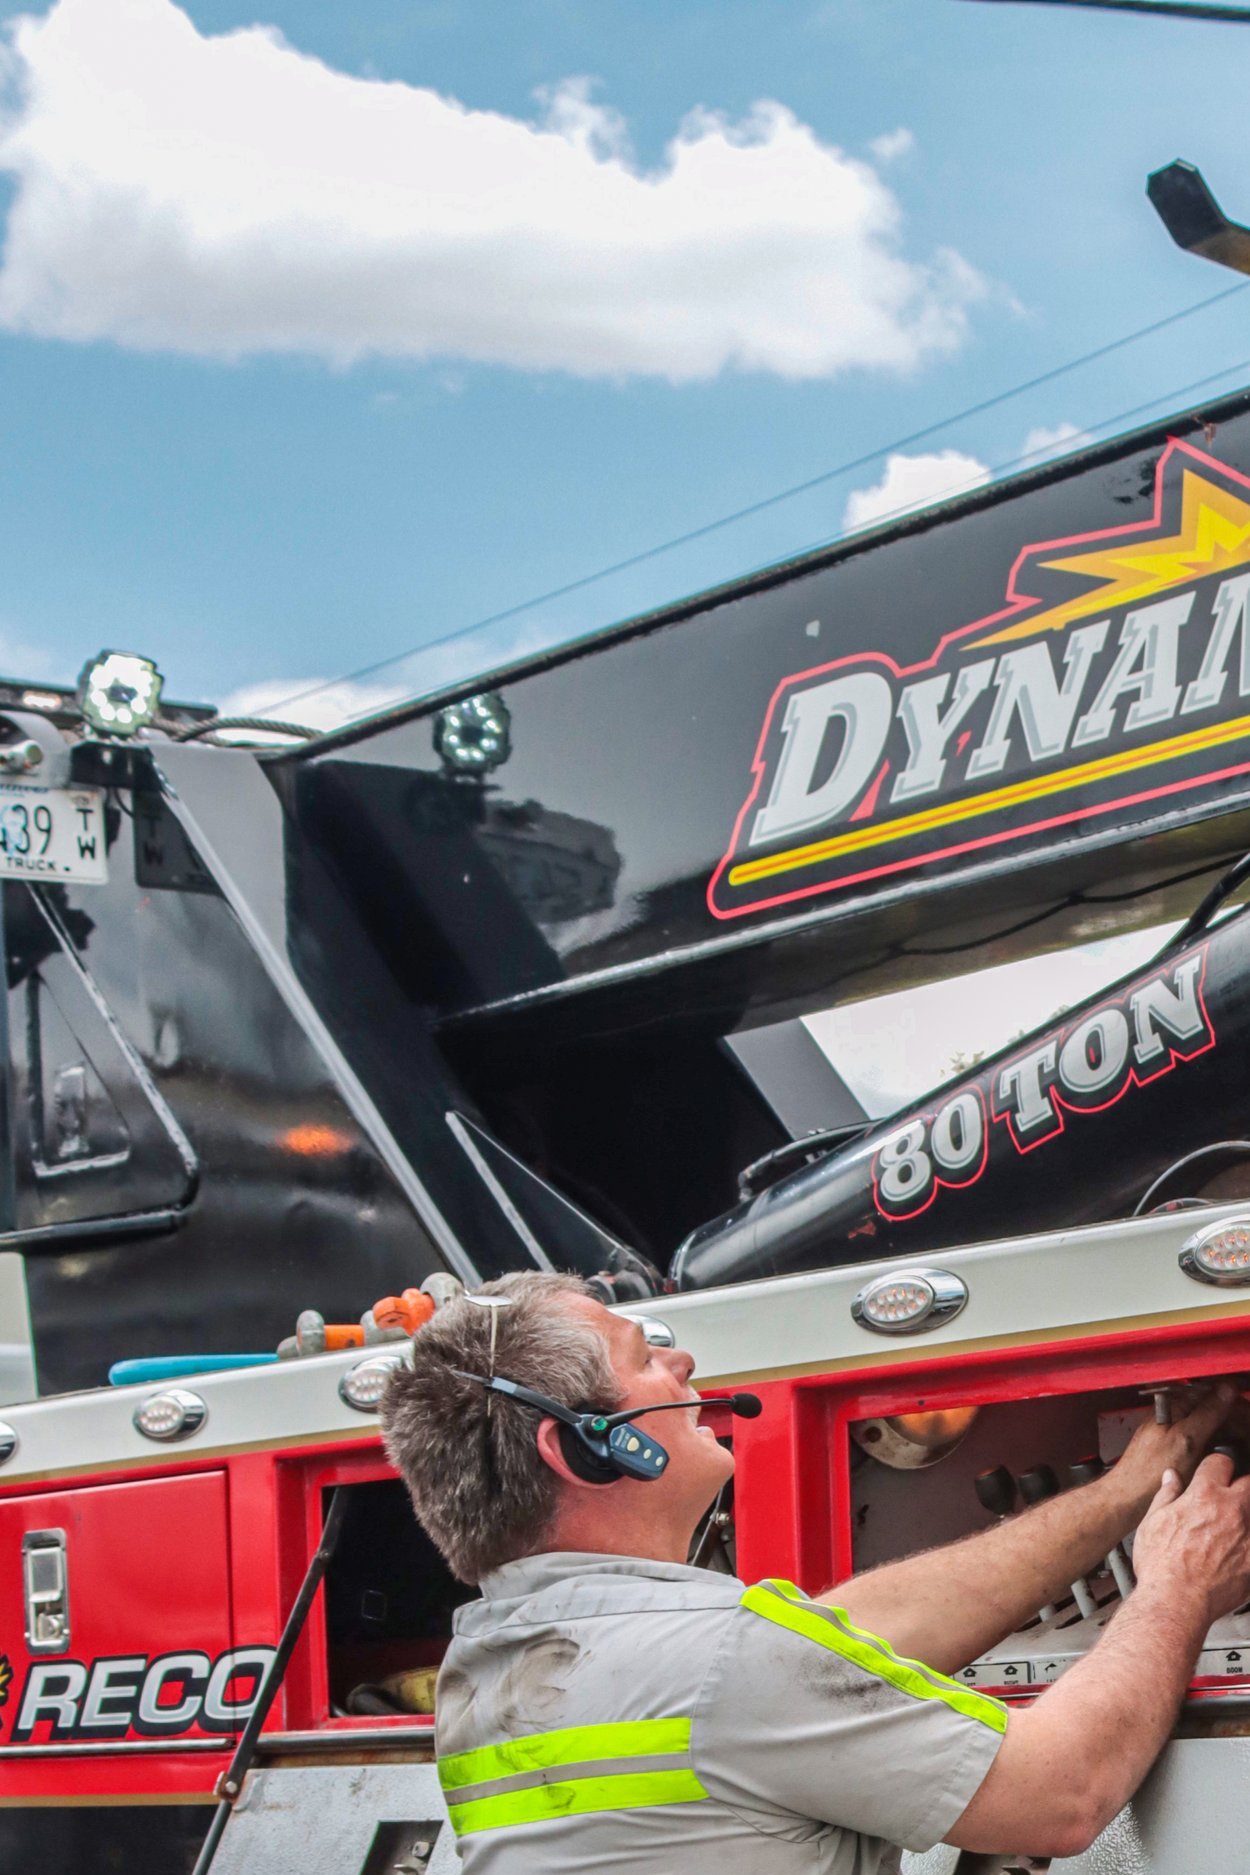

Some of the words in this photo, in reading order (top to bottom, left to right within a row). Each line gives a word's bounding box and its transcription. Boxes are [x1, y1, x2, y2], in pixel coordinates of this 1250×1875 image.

[6, 856, 57, 871] TRUCK
[879, 1092, 983, 1202] 80
[1000, 954, 1204, 1132] TON
[15, 1648, 279, 1733] RECO
